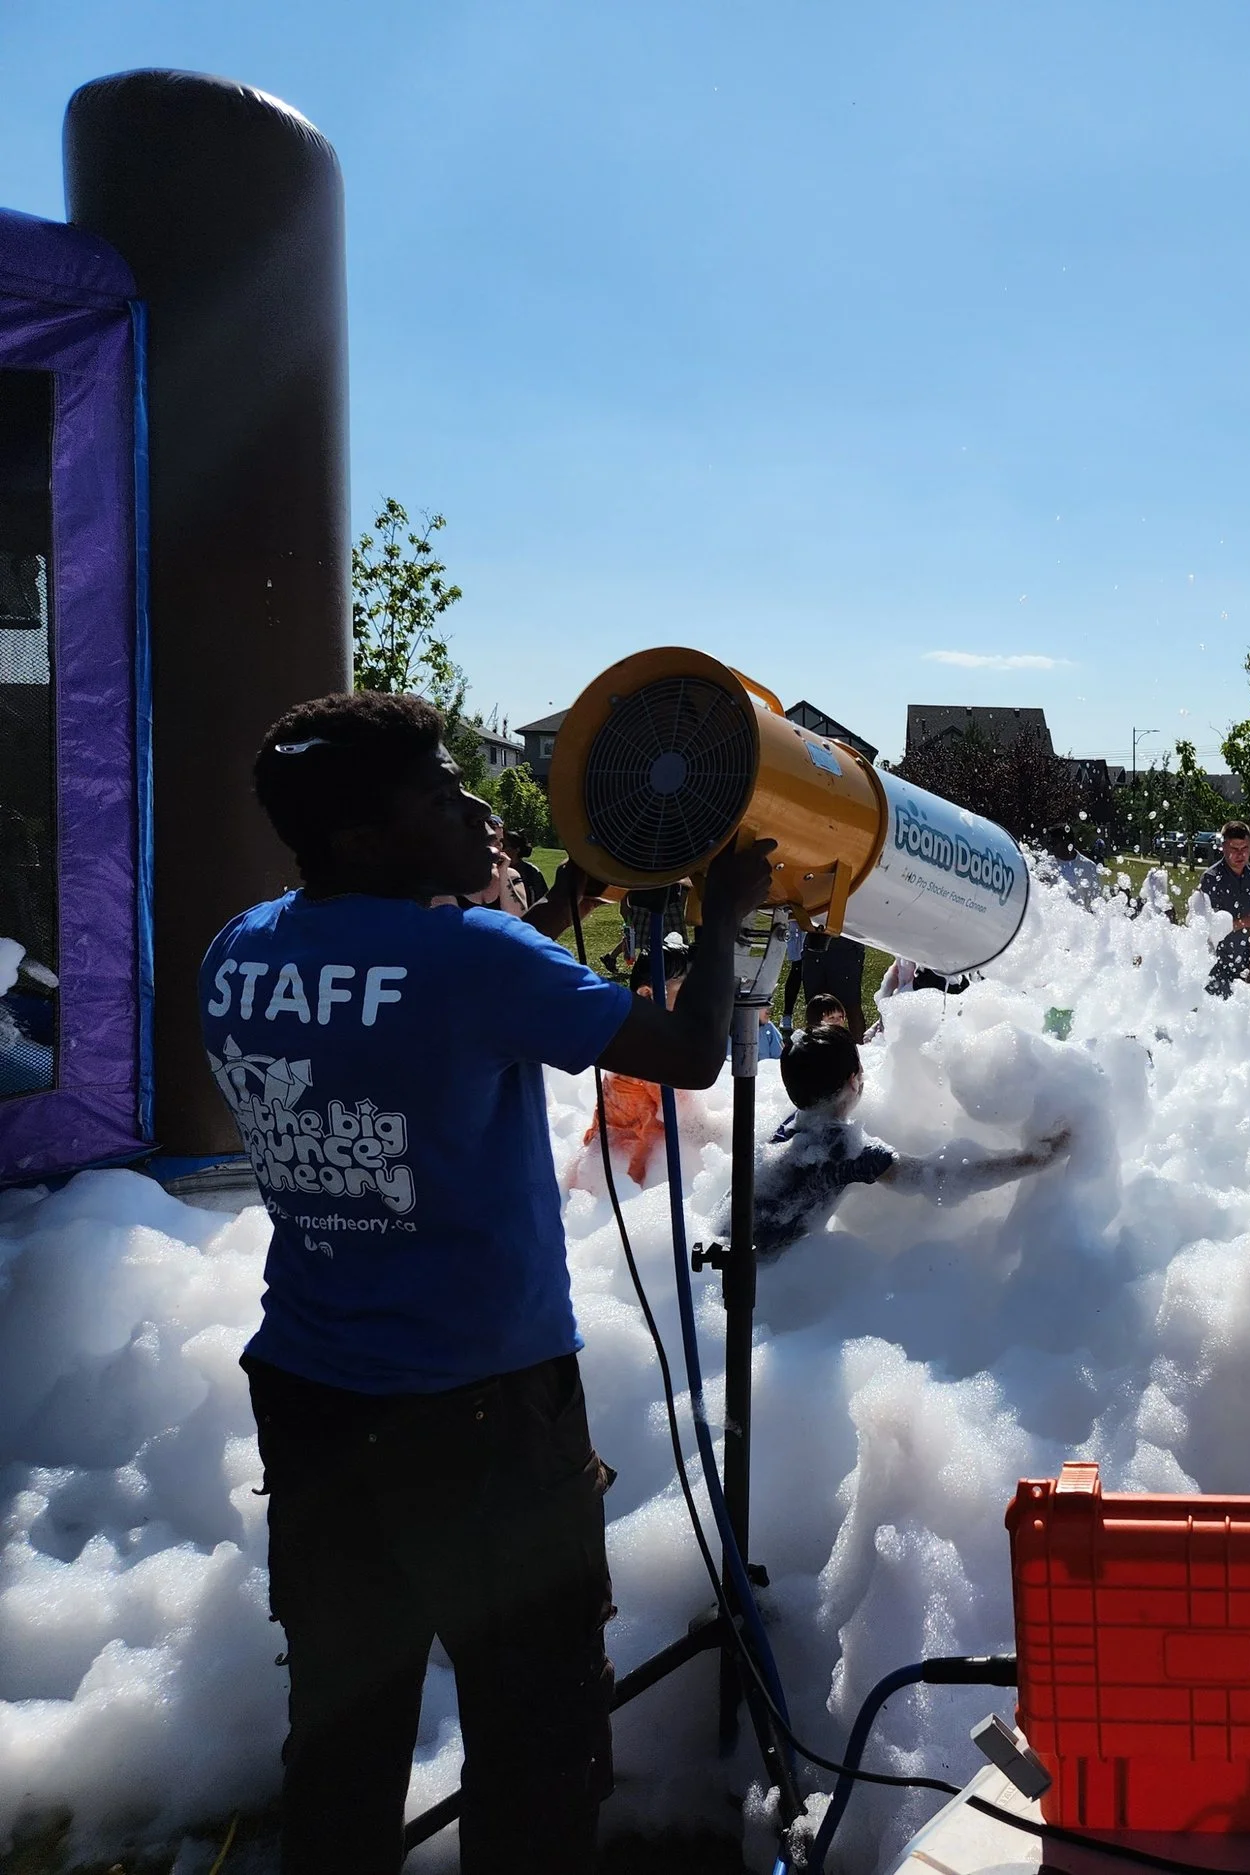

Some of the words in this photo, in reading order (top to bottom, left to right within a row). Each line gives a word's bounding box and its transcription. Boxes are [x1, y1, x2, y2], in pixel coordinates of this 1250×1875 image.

[894, 804, 954, 871] Foam
[954, 834, 1014, 906] Daddy
[916, 876, 928, 889] Pro
[949, 891, 966, 905] Foam
[208, 959, 408, 1026] STAFF
[251, 1095, 323, 1139] the
[328, 1099, 407, 1157] big
[250, 1148, 416, 1215] theory
